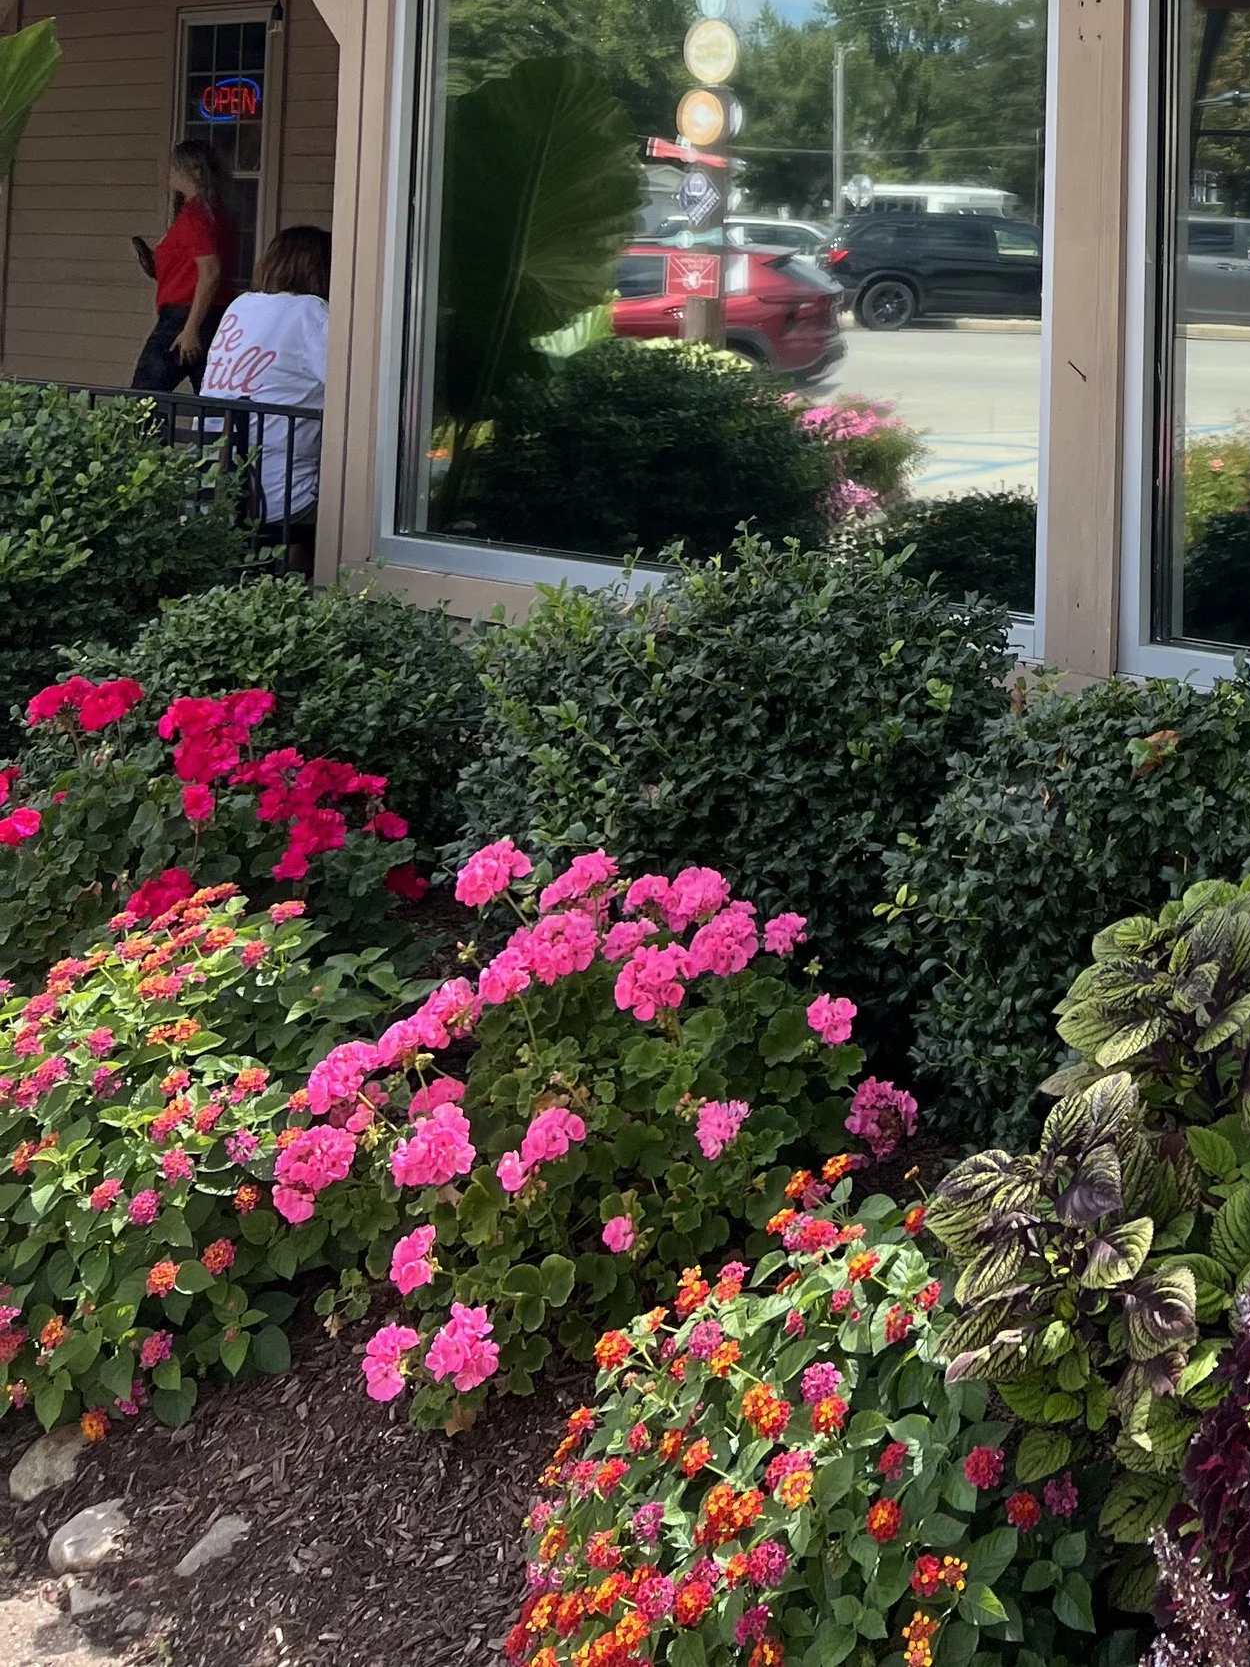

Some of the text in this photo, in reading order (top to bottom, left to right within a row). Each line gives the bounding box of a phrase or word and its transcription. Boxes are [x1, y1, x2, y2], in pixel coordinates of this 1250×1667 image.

[202, 86, 258, 115] OPEN
[210, 313, 244, 353] Be
[201, 346, 277, 393] till
